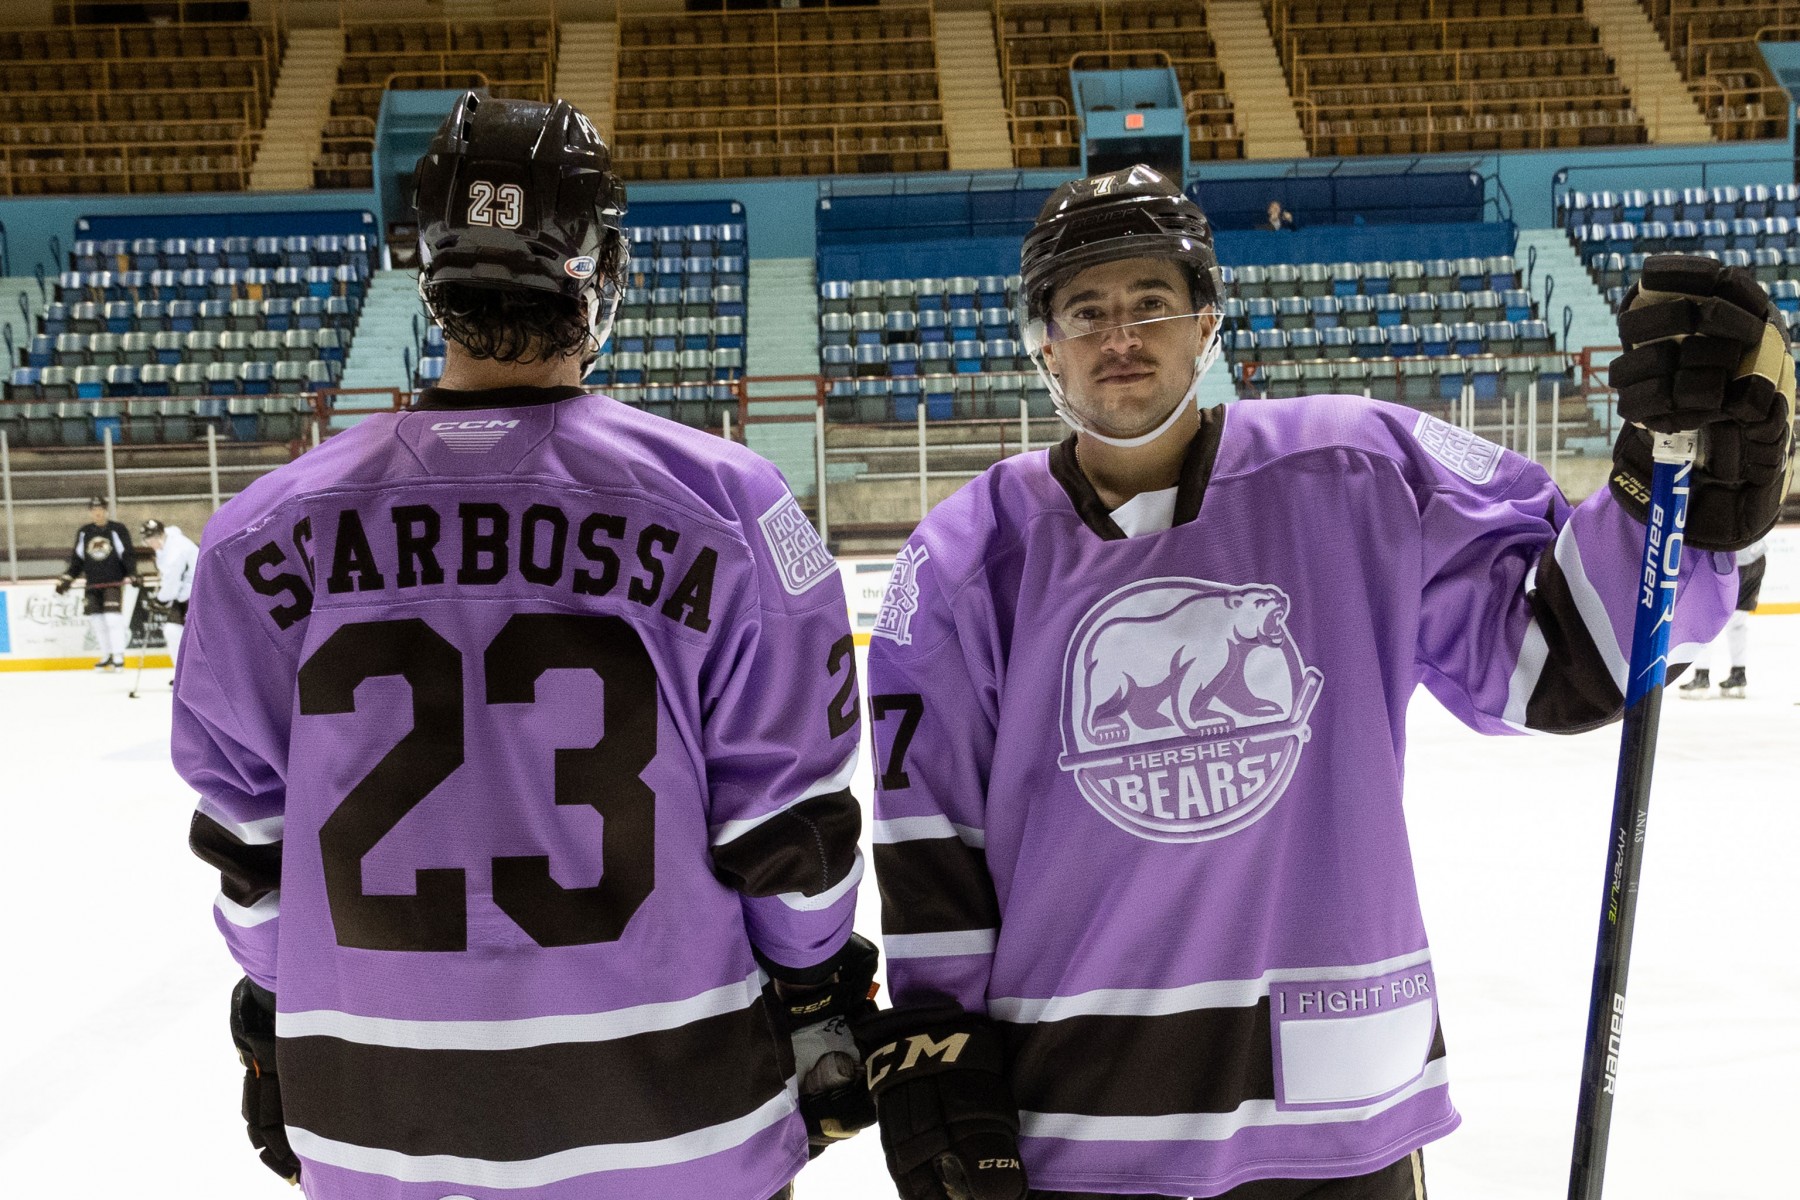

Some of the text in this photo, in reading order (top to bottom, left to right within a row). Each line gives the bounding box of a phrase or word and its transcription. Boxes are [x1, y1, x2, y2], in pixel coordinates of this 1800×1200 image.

[467, 180, 524, 230] 23
[1091, 176, 1116, 196] 7
[430, 419, 520, 431] CCM
[1614, 475, 1651, 505] CCM
[780, 523, 821, 562] FIGH
[862, 587, 884, 598] thri
[868, 694, 924, 791] 7
[1129, 738, 1248, 771] HERSHEY
[298, 613, 657, 952] 23
[1113, 754, 1267, 819] BEARS
[1634, 810, 1647, 843] ANAS
[1608, 827, 1627, 925] HYPERLITE
[1279, 973, 1430, 1014] I FIGHT FOR
[865, 1032, 970, 1090] CM
[978, 1158, 1020, 1170] CCM
